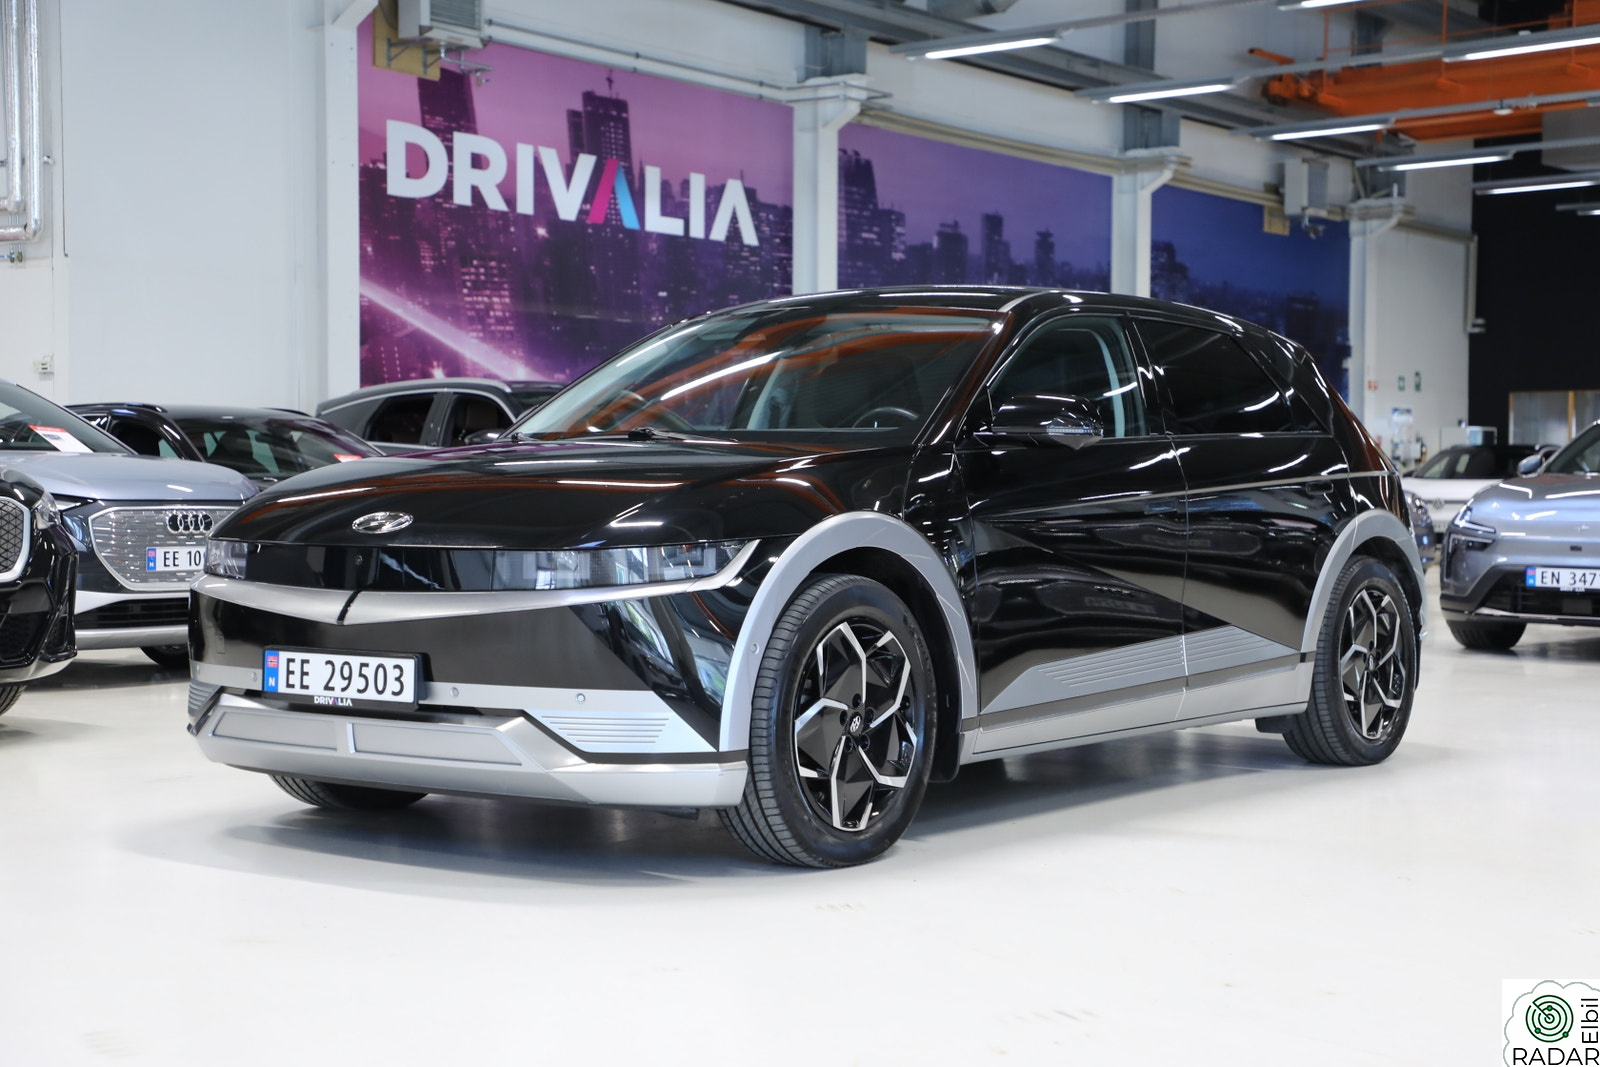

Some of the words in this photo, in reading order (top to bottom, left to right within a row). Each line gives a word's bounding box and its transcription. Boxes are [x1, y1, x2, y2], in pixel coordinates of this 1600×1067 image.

[386, 119, 759, 247] DRIVALIA
[163, 551, 179, 567] EE
[187, 550, 203, 567] 10
[1541, 571, 1560, 585] EN
[1569, 571, 1600, 586] 347
[268, 677, 275, 687] N
[285, 658, 310, 690] EE
[323, 660, 405, 697] 29503
[314, 695, 353, 707] DRIVALIA
